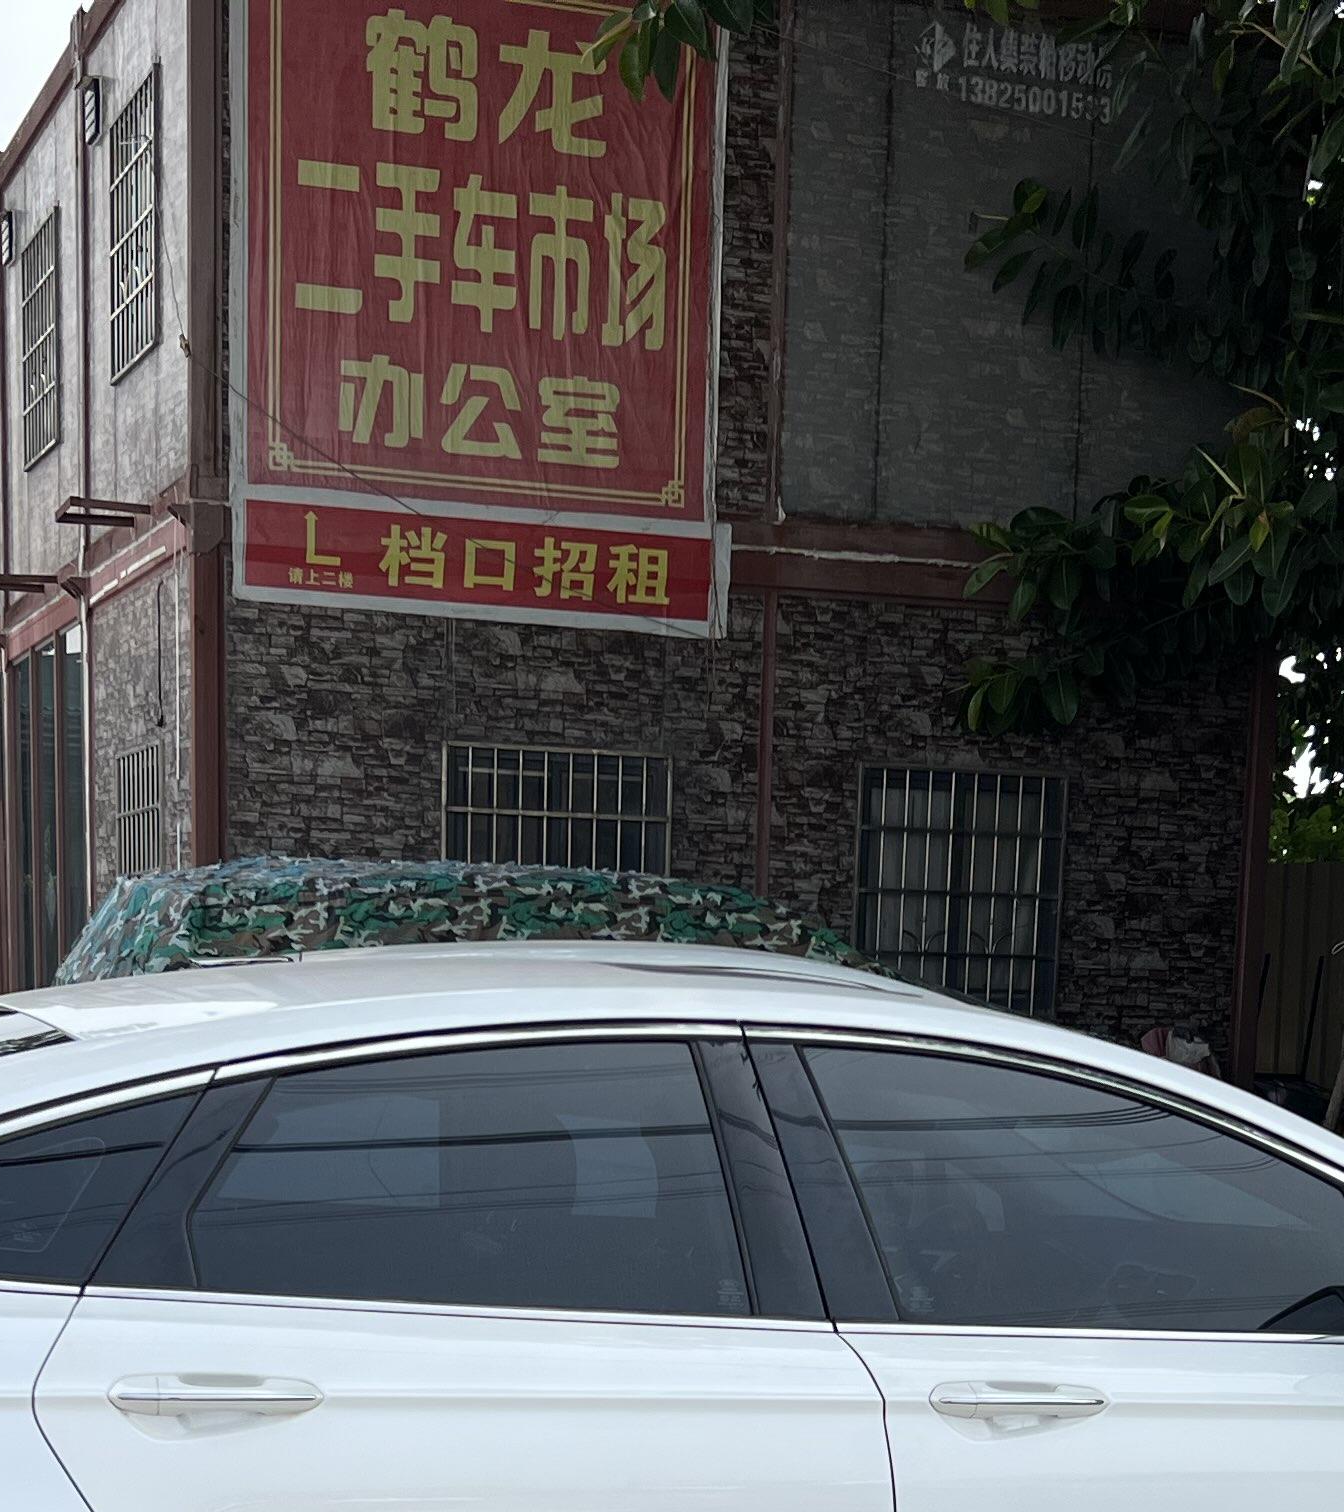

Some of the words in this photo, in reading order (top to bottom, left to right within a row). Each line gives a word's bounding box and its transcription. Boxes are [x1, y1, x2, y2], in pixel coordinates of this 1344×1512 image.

[366, 8, 607, 157] 鹤龙
[295, 159, 667, 351] 二手车市场
[338, 354, 620, 469] 办公室
[288, 567, 353, 589] 请上二楼
[379, 524, 670, 605] 档口招租
